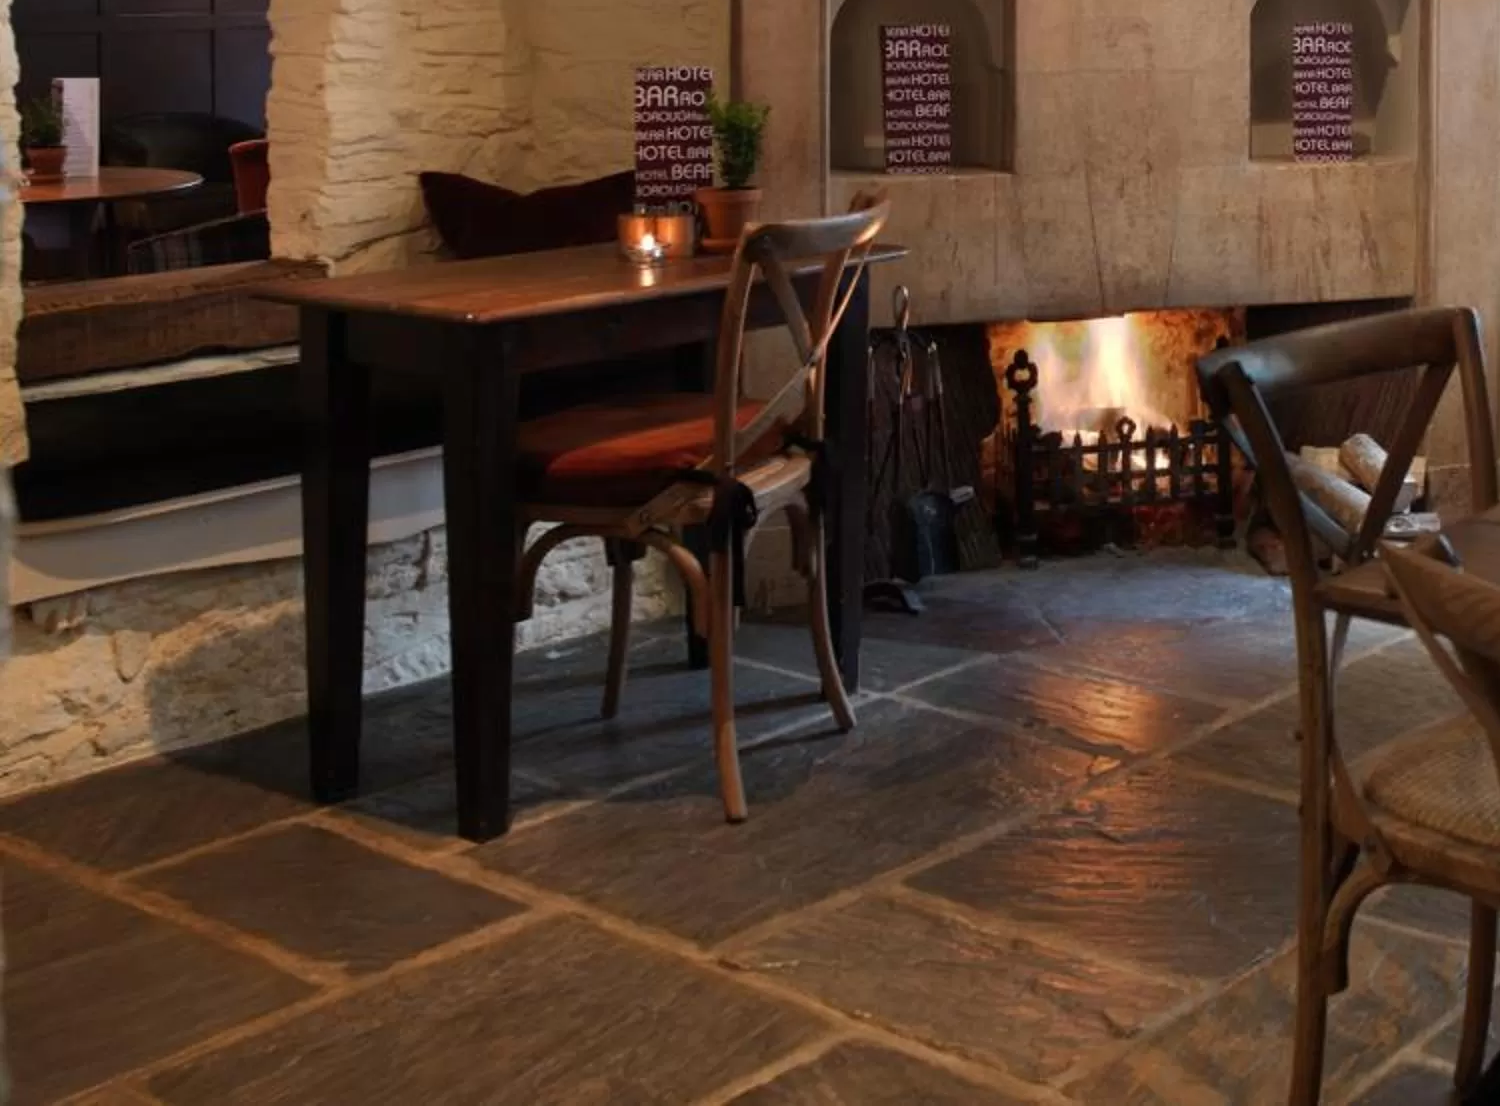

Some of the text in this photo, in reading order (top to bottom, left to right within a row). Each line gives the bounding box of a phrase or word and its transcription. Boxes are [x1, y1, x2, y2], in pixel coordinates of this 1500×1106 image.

[885, 39, 920, 58] BAR
[1292, 36, 1326, 54] BAR
[635, 85, 706, 108] BAR RO
